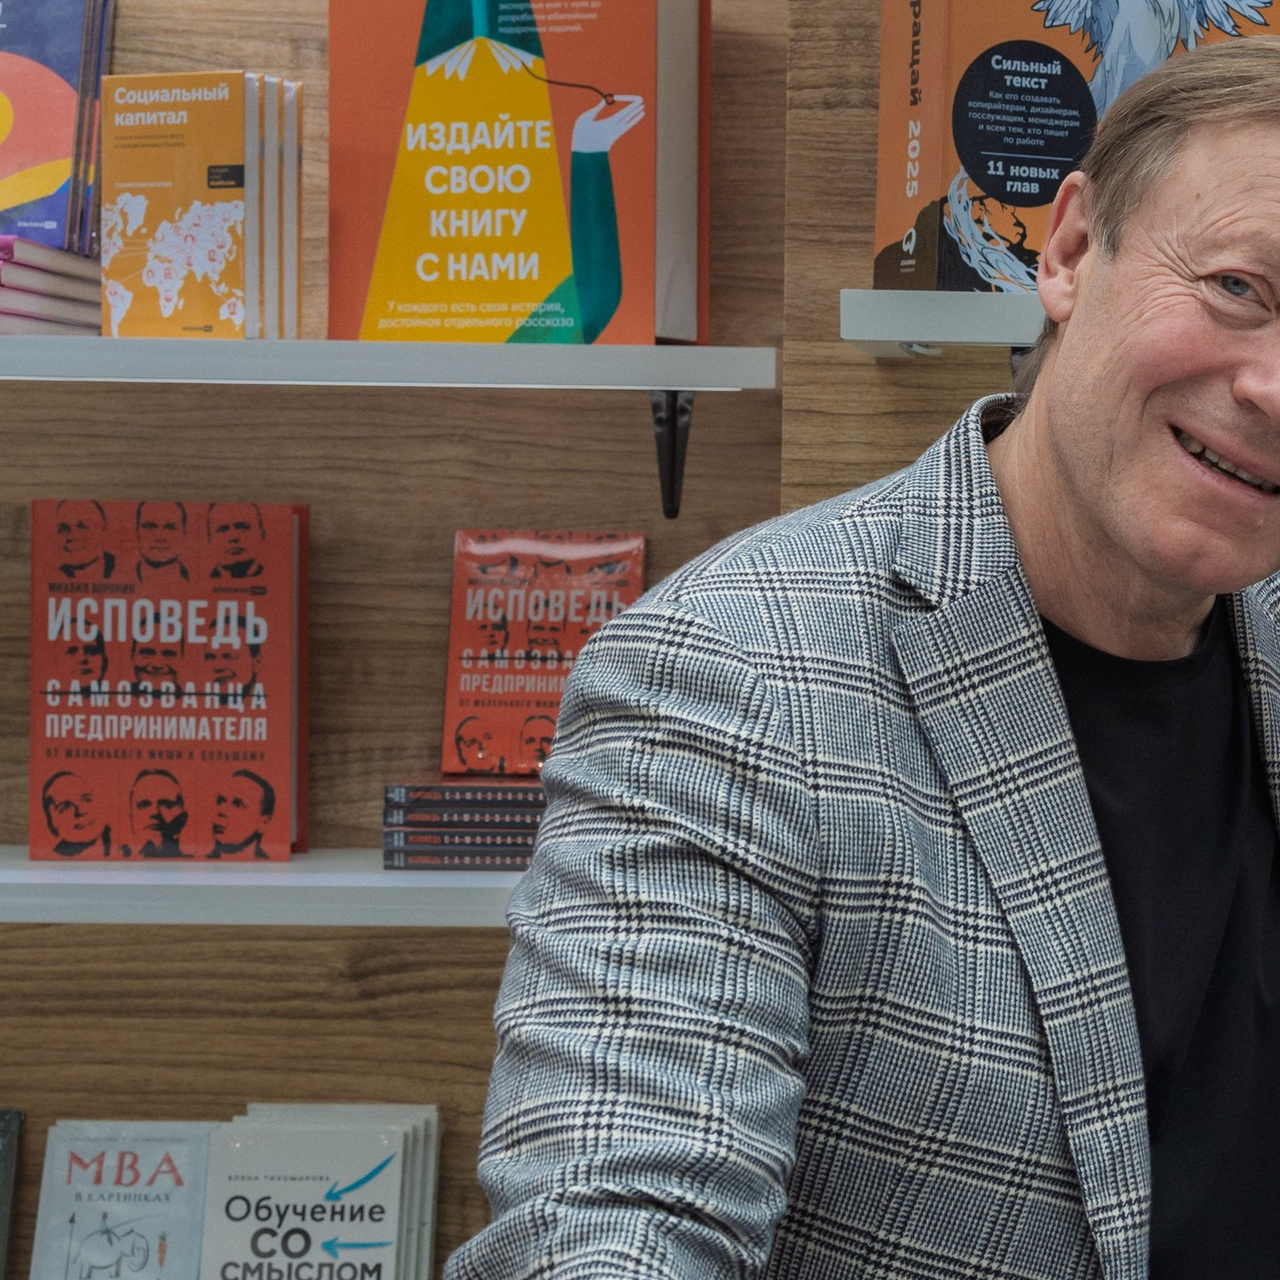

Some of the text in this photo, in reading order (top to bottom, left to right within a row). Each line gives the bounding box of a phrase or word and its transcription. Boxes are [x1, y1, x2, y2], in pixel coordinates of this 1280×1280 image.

[991, 55, 1062, 75] Сильный
[1004, 74, 1048, 89] текст
[114, 82, 229, 105] Социальный
[989, 90, 1061, 104] Как его создавать
[114, 110, 188, 127] капитал
[968, 100, 1081, 117] копирайтерам, дизайнерам,
[968, 111, 1080, 128] госслужащим, менеджерам
[406, 113, 551, 155] ИЗДАЙТЕ
[986, 124, 1006, 132] всем
[1008, 126, 1025, 134] тем,
[1027, 127, 1042, 135] кто
[1043, 128, 1069, 137] пишет
[1003, 135, 1045, 147] по работе
[905, 119, 921, 199] 2025
[987, 160, 1060, 180] 11 новых
[425, 164, 531, 195] СВОЮ
[1006, 180, 1040, 194] глав
[430, 208, 527, 237] КНИГУ
[416, 253, 539, 282] С НАМИ
[465, 588, 627, 626] ИСПОВЕДЬ
[47, 597, 268, 650] ИСПОВЕДЬ
[461, 647, 575, 670] САМОЗВА
[460, 673, 566, 694] ПРЕДПРИНИ
[46, 678, 267, 713] САМОЗВАНЦА
[45, 713, 268, 742] ПРЕДПРИНИМАТЕЛЯ
[66, 1150, 185, 1187] MBA
[87, 1191, 171, 1202] КАРТИНКАХ
[225, 1195, 386, 1229] Обучение
[250, 1227, 312, 1259] СО
